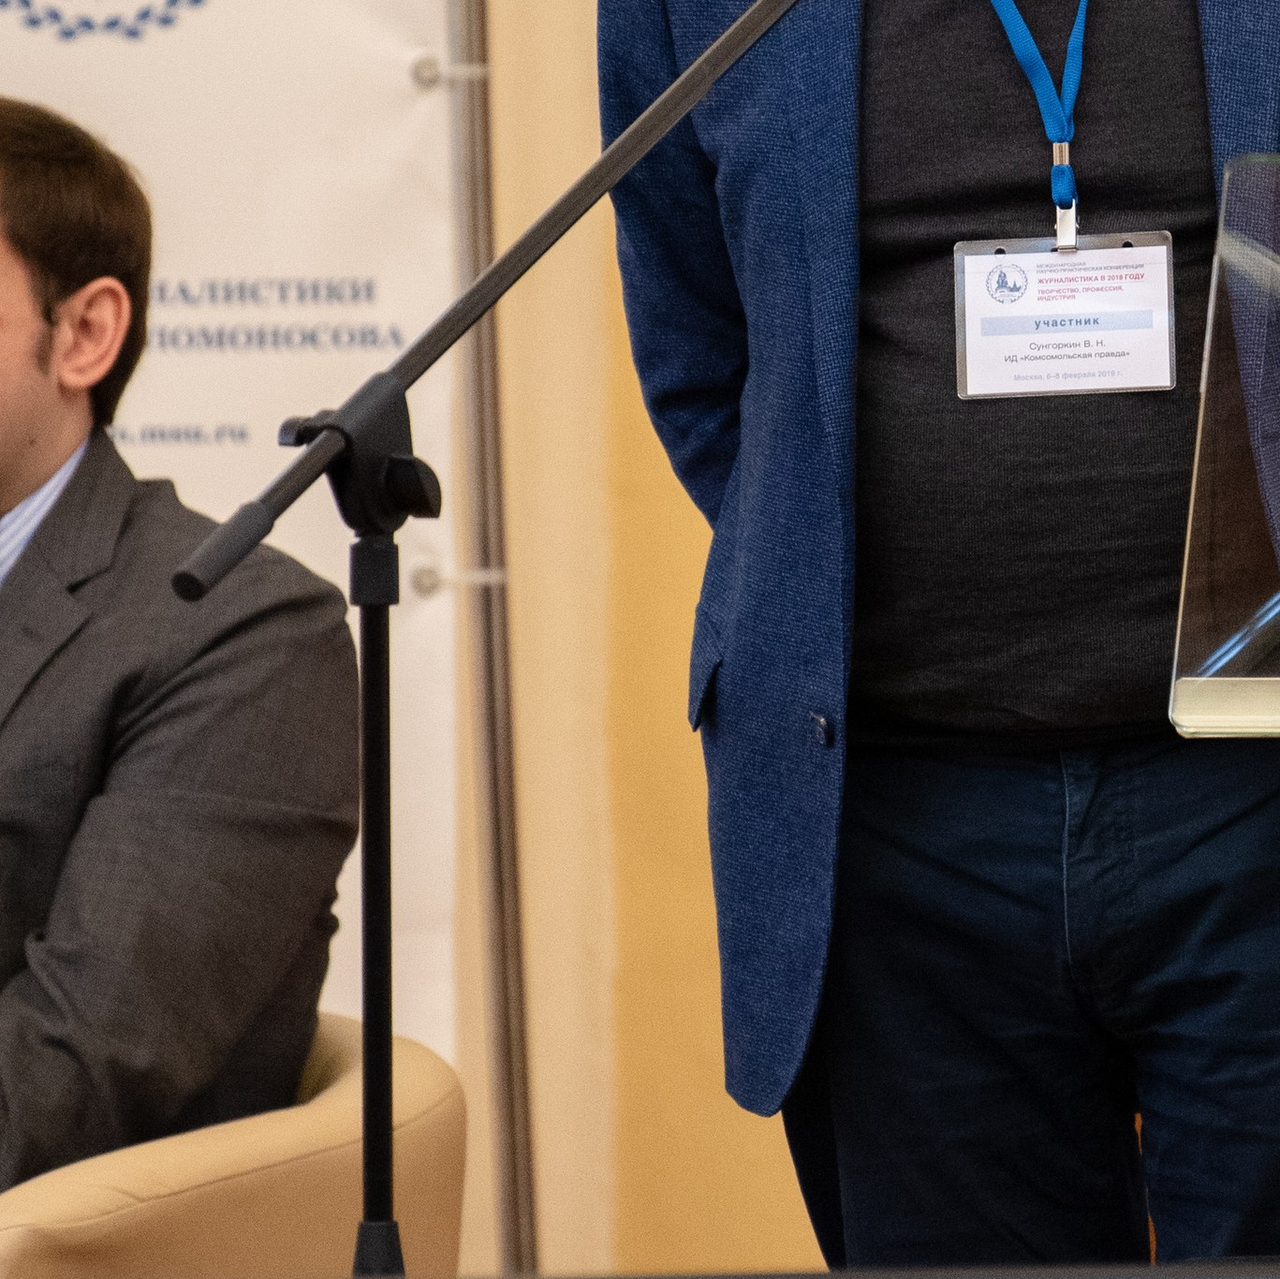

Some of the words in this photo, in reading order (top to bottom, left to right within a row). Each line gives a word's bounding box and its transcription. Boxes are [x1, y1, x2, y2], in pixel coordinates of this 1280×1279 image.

[1103, 263, 1145, 271] КОНФЕРЕНЦИЯ
[1037, 275, 1099, 285] ЖУРНАЛИСТИКА
[1037, 287, 1081, 295] ТВОРЧЕСТВО,
[1082, 285, 1124, 293] ПРОФЕССИЯ,
[1037, 294, 1076, 302] ИНДУСТРИЯ
[1034, 317, 1100, 330] участник
[1029, 341, 1081, 352] Сунгоркин
[1083, 340, 1093, 348] В.
[1096, 339, 1106, 347] Н.
[1004, 354, 1018, 363] ИД
[1020, 351, 1093, 362] «Комсомольская
[1094, 350, 1130, 359] правда»
[1013, 373, 1043, 382] Москва,
